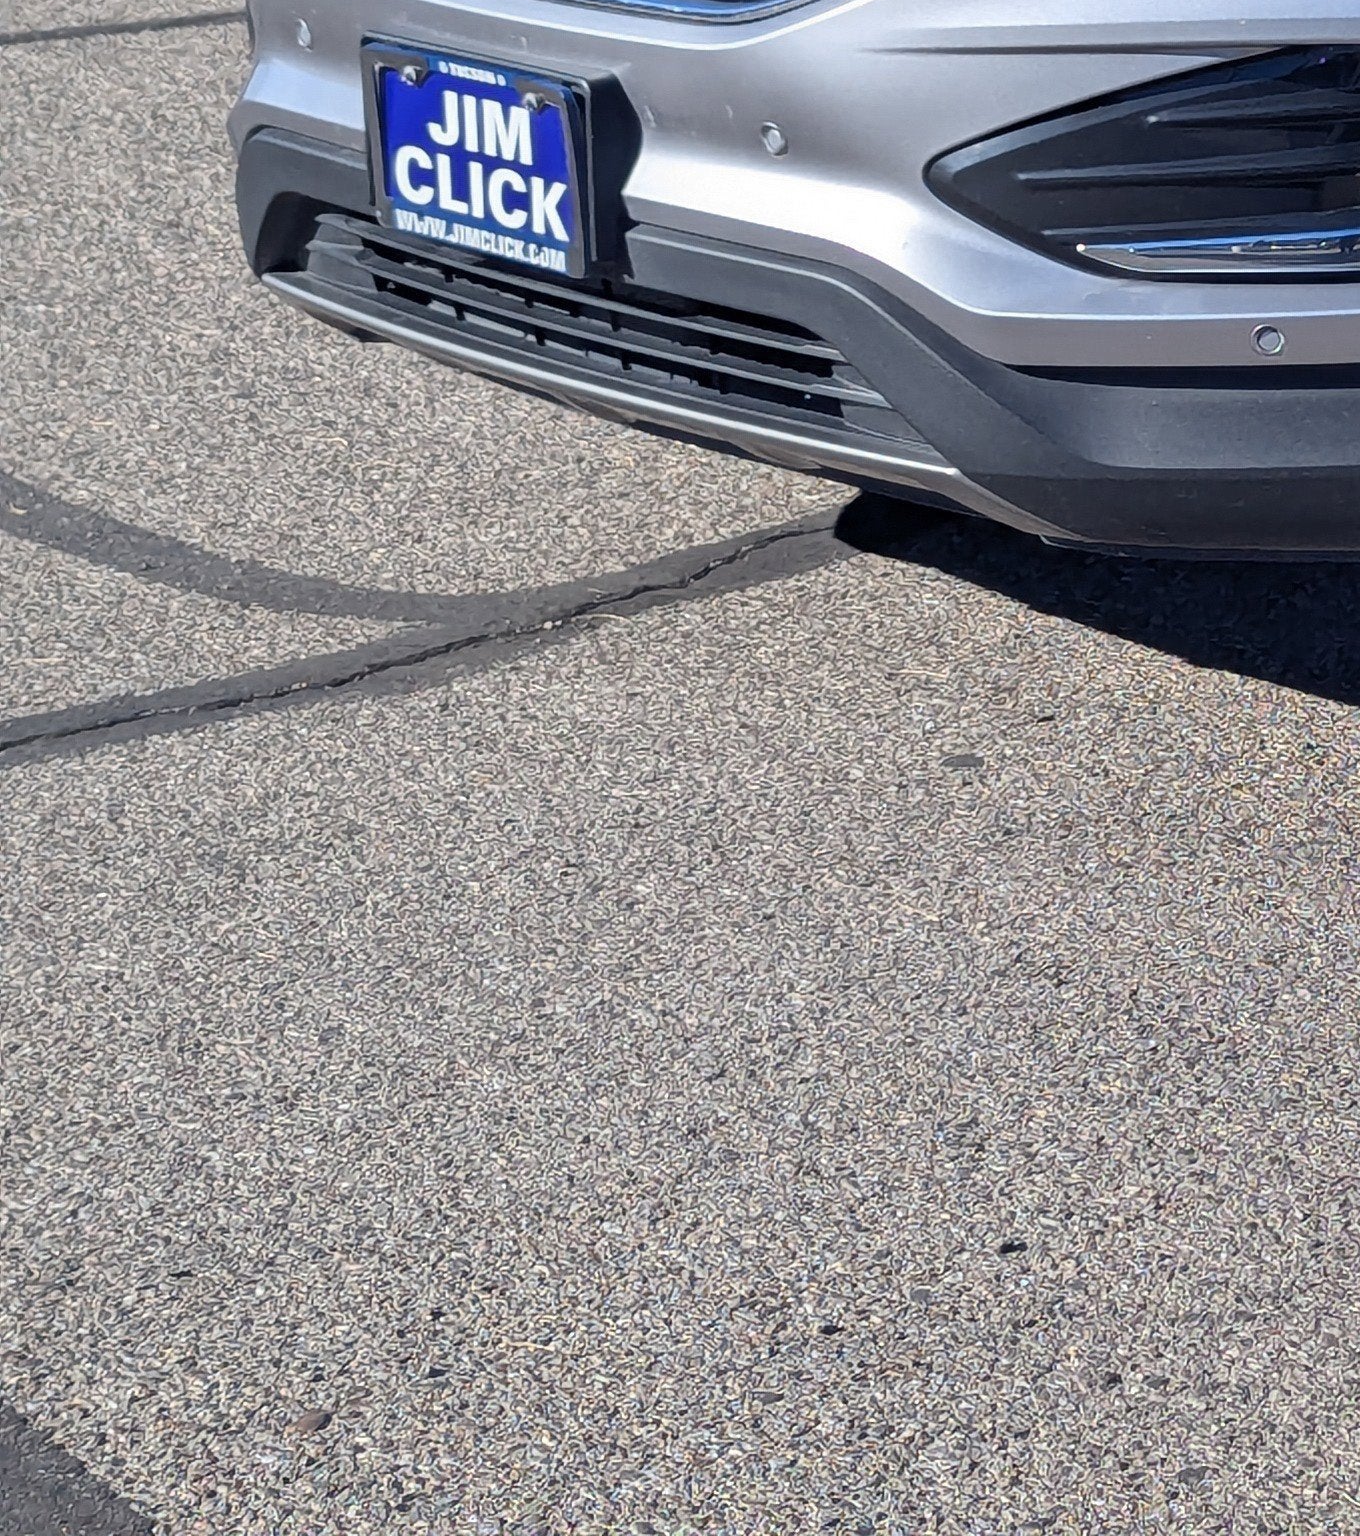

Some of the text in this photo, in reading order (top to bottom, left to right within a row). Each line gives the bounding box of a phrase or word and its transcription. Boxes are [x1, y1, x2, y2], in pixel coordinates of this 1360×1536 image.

[425, 89, 534, 166] JIM
[393, 144, 570, 243] CLICK
[394, 207, 568, 273] WWW.JIMCLICK.COM
